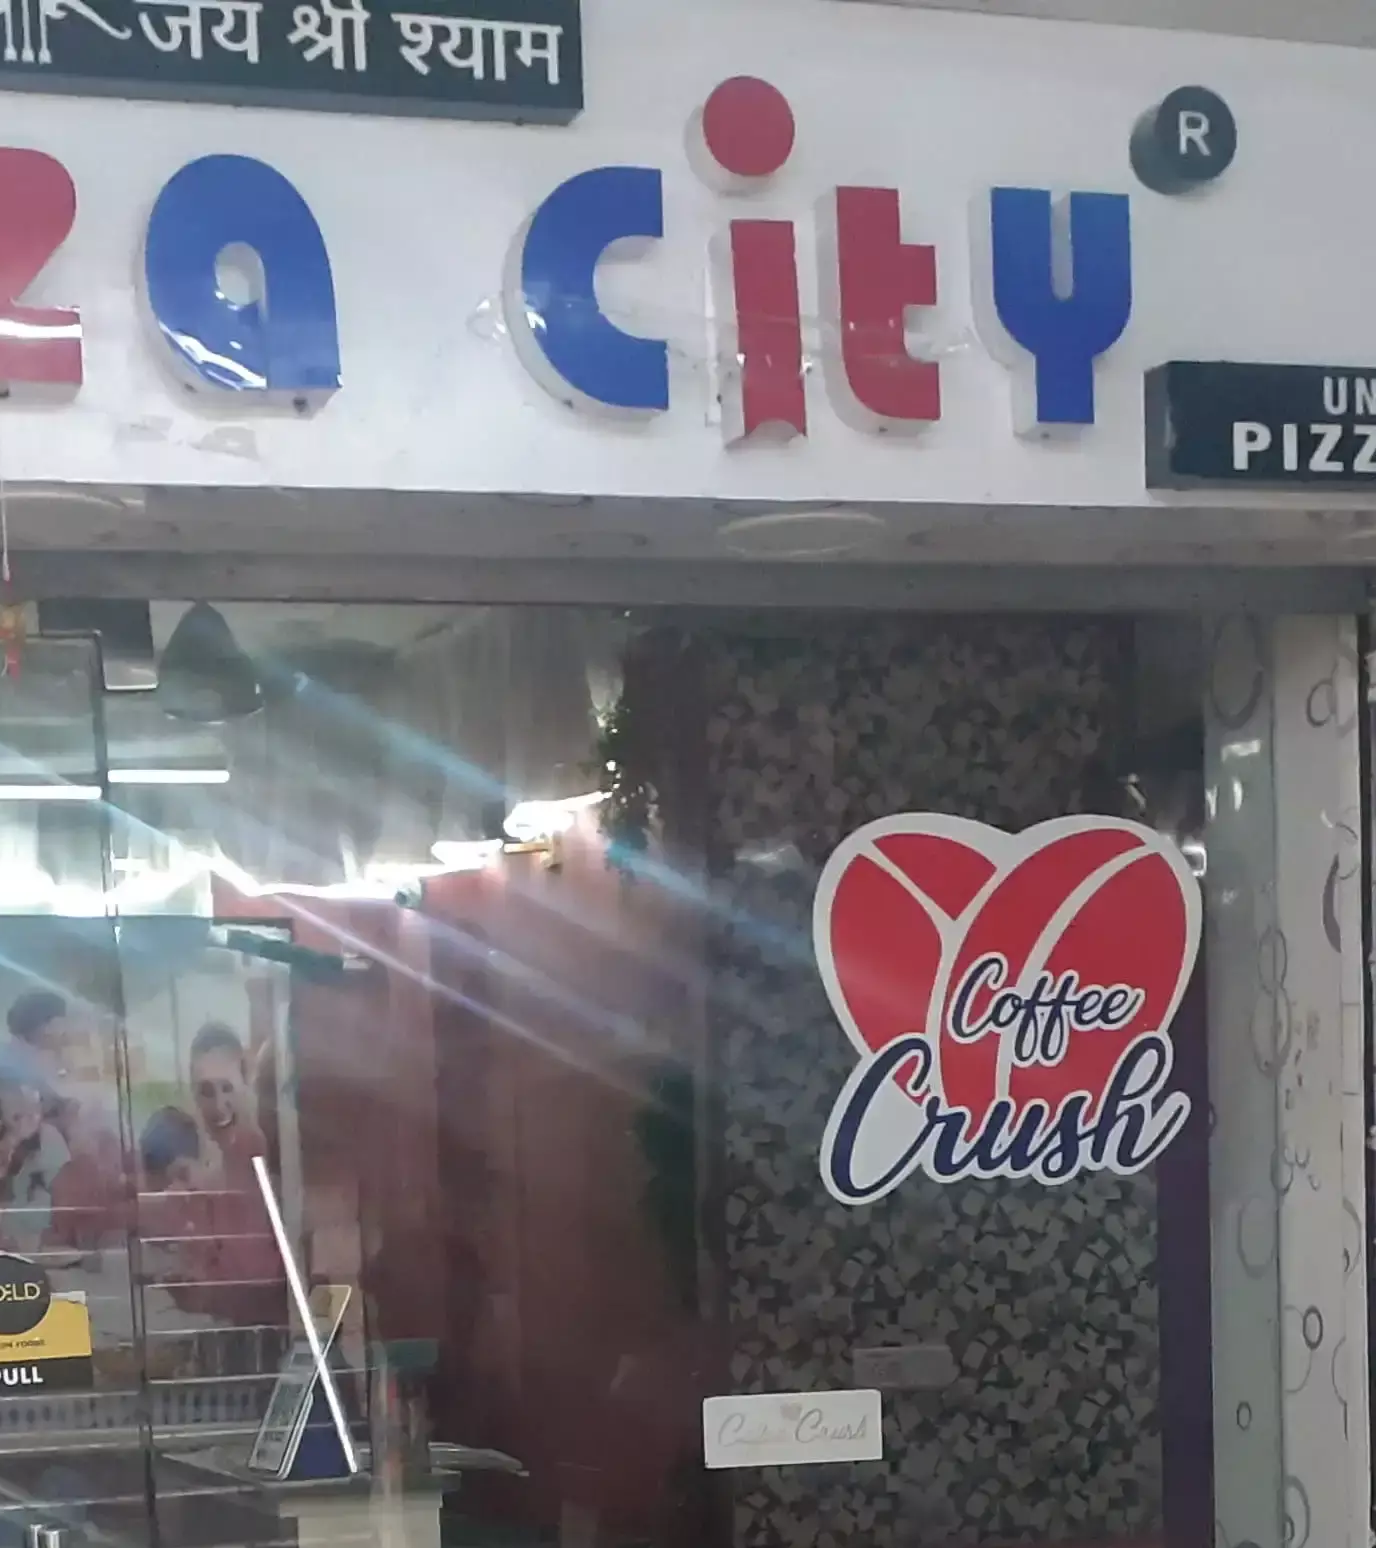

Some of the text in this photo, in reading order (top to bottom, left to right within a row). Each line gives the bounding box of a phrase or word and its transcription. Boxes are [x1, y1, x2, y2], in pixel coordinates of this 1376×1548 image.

[139, 0, 263, 62] जय
[392, 10, 564, 86] श्याम
[512, 76, 1133, 438] City
[950, 957, 1142, 1062] Coffee
[829, 1036, 1185, 1198] Crush
